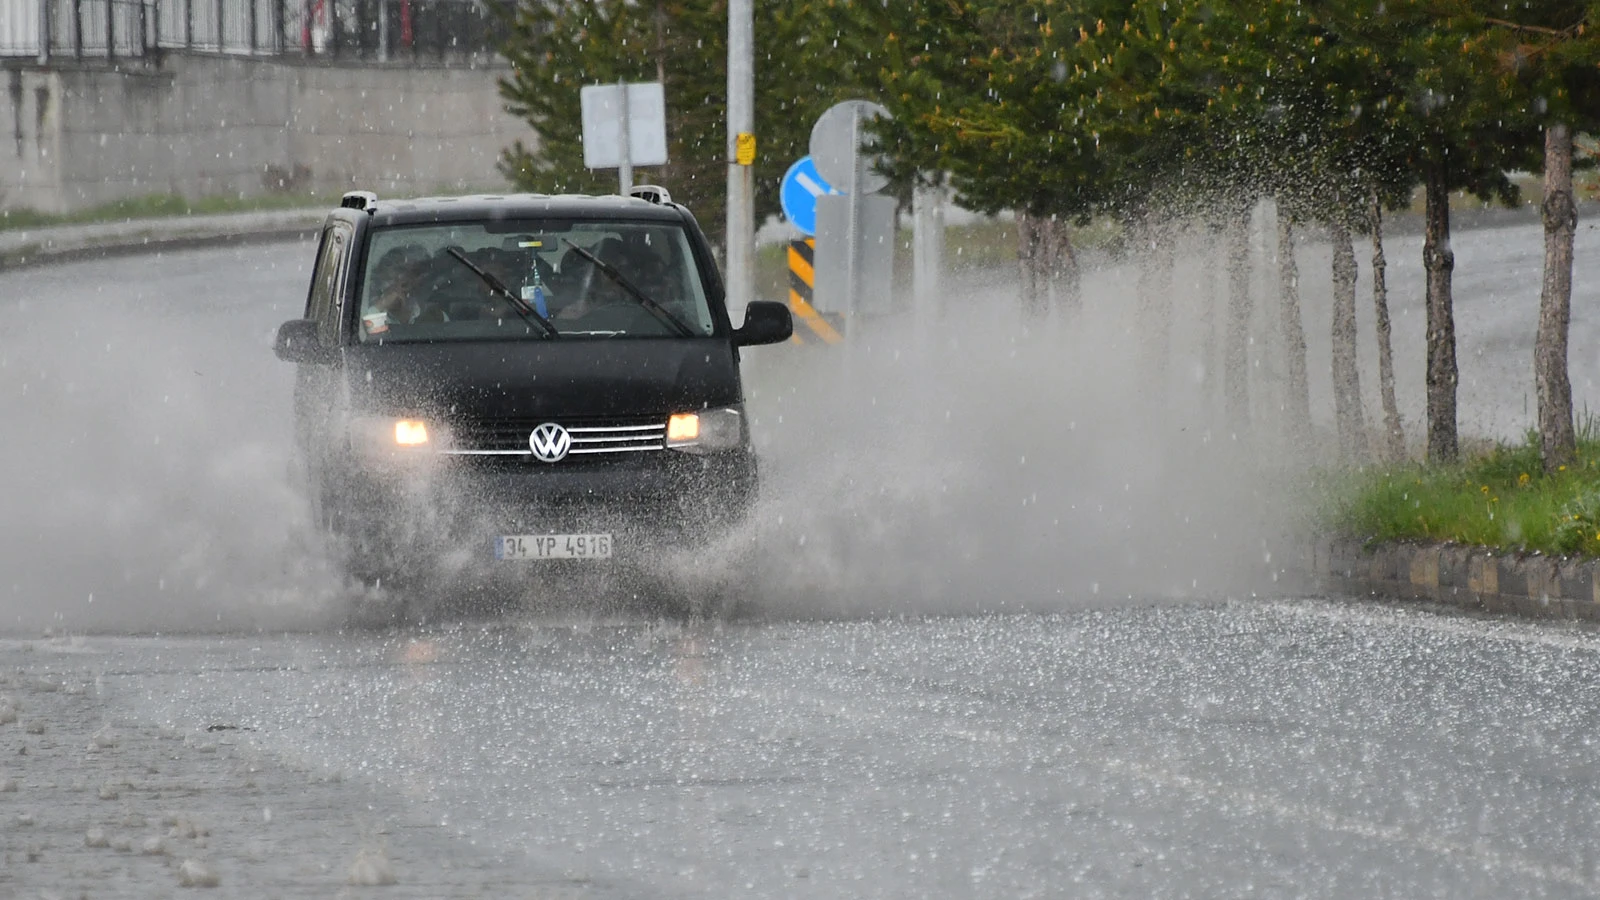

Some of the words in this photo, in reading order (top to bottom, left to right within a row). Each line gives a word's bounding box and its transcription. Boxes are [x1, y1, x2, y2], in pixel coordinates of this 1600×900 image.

[529, 422, 571, 462] VW
[506, 538, 527, 556] 34
[536, 538, 556, 556] YP
[566, 537, 609, 555] 4916
